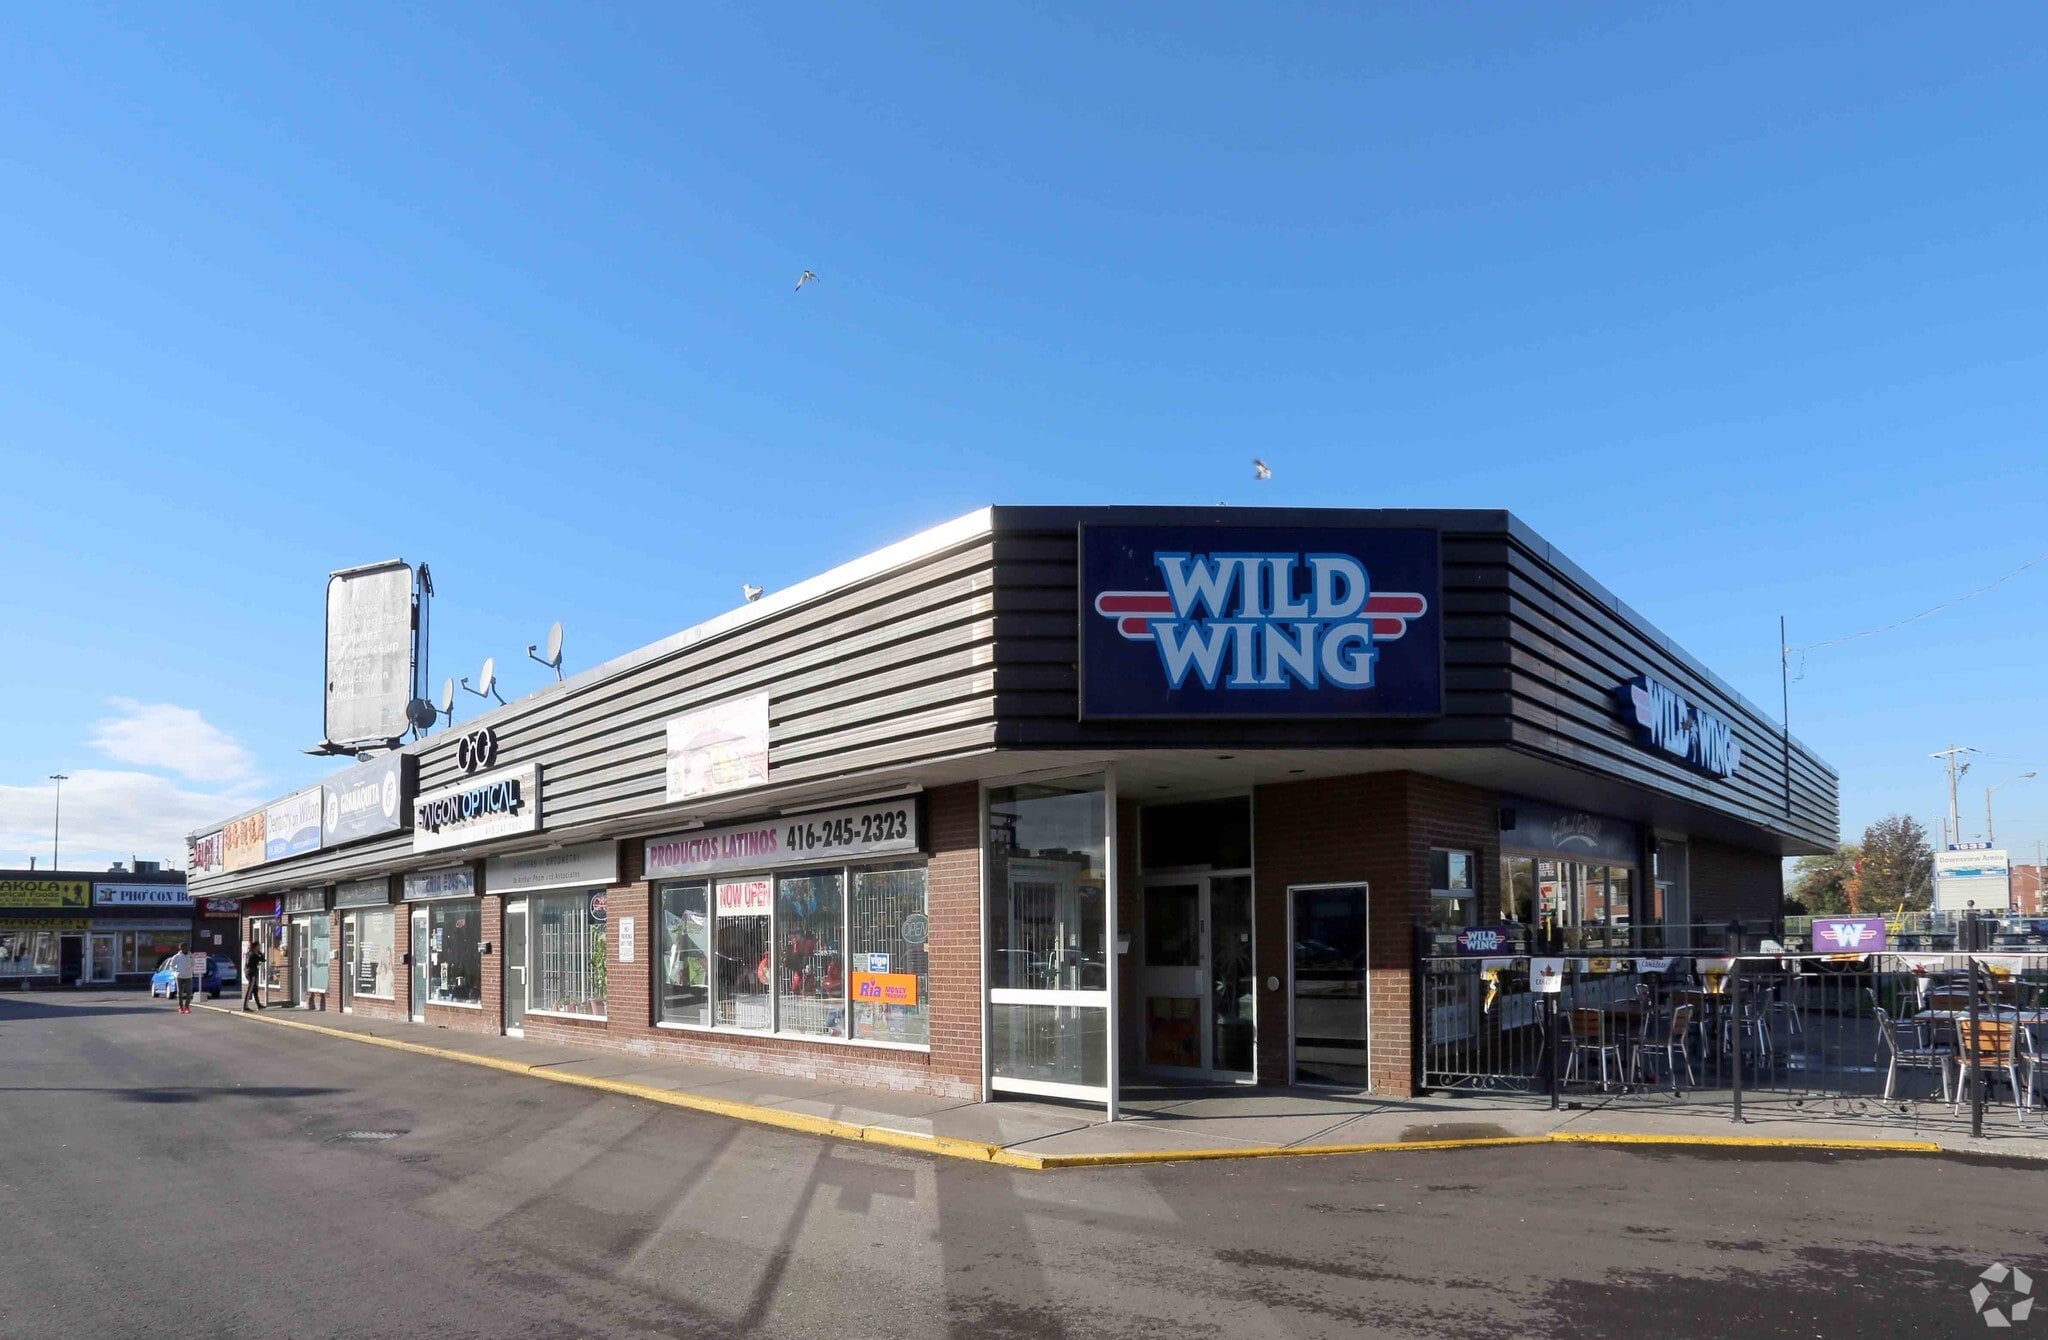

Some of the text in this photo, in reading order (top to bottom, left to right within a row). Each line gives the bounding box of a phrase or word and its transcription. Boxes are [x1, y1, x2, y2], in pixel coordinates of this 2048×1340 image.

[1153, 552, 1371, 621] WILD
[1147, 618, 1379, 690] WING
[1645, 676, 1734, 779] WILD WING
[418, 779, 518, 828] SAIGON OPTICAL
[650, 810, 908, 869] PRODUCTOS LATINOS 416-245-2323
[1939, 855, 1981, 863] Downsview
[555, 871, 581, 880] Associates
[720, 882, 771, 908] NOW OPEN
[904, 921, 927, 938] OPEN
[1467, 931, 1497, 941] WILD
[1830, 923, 1868, 948] W
[1466, 940, 1498, 951] WING
[860, 979, 882, 998] Ria
